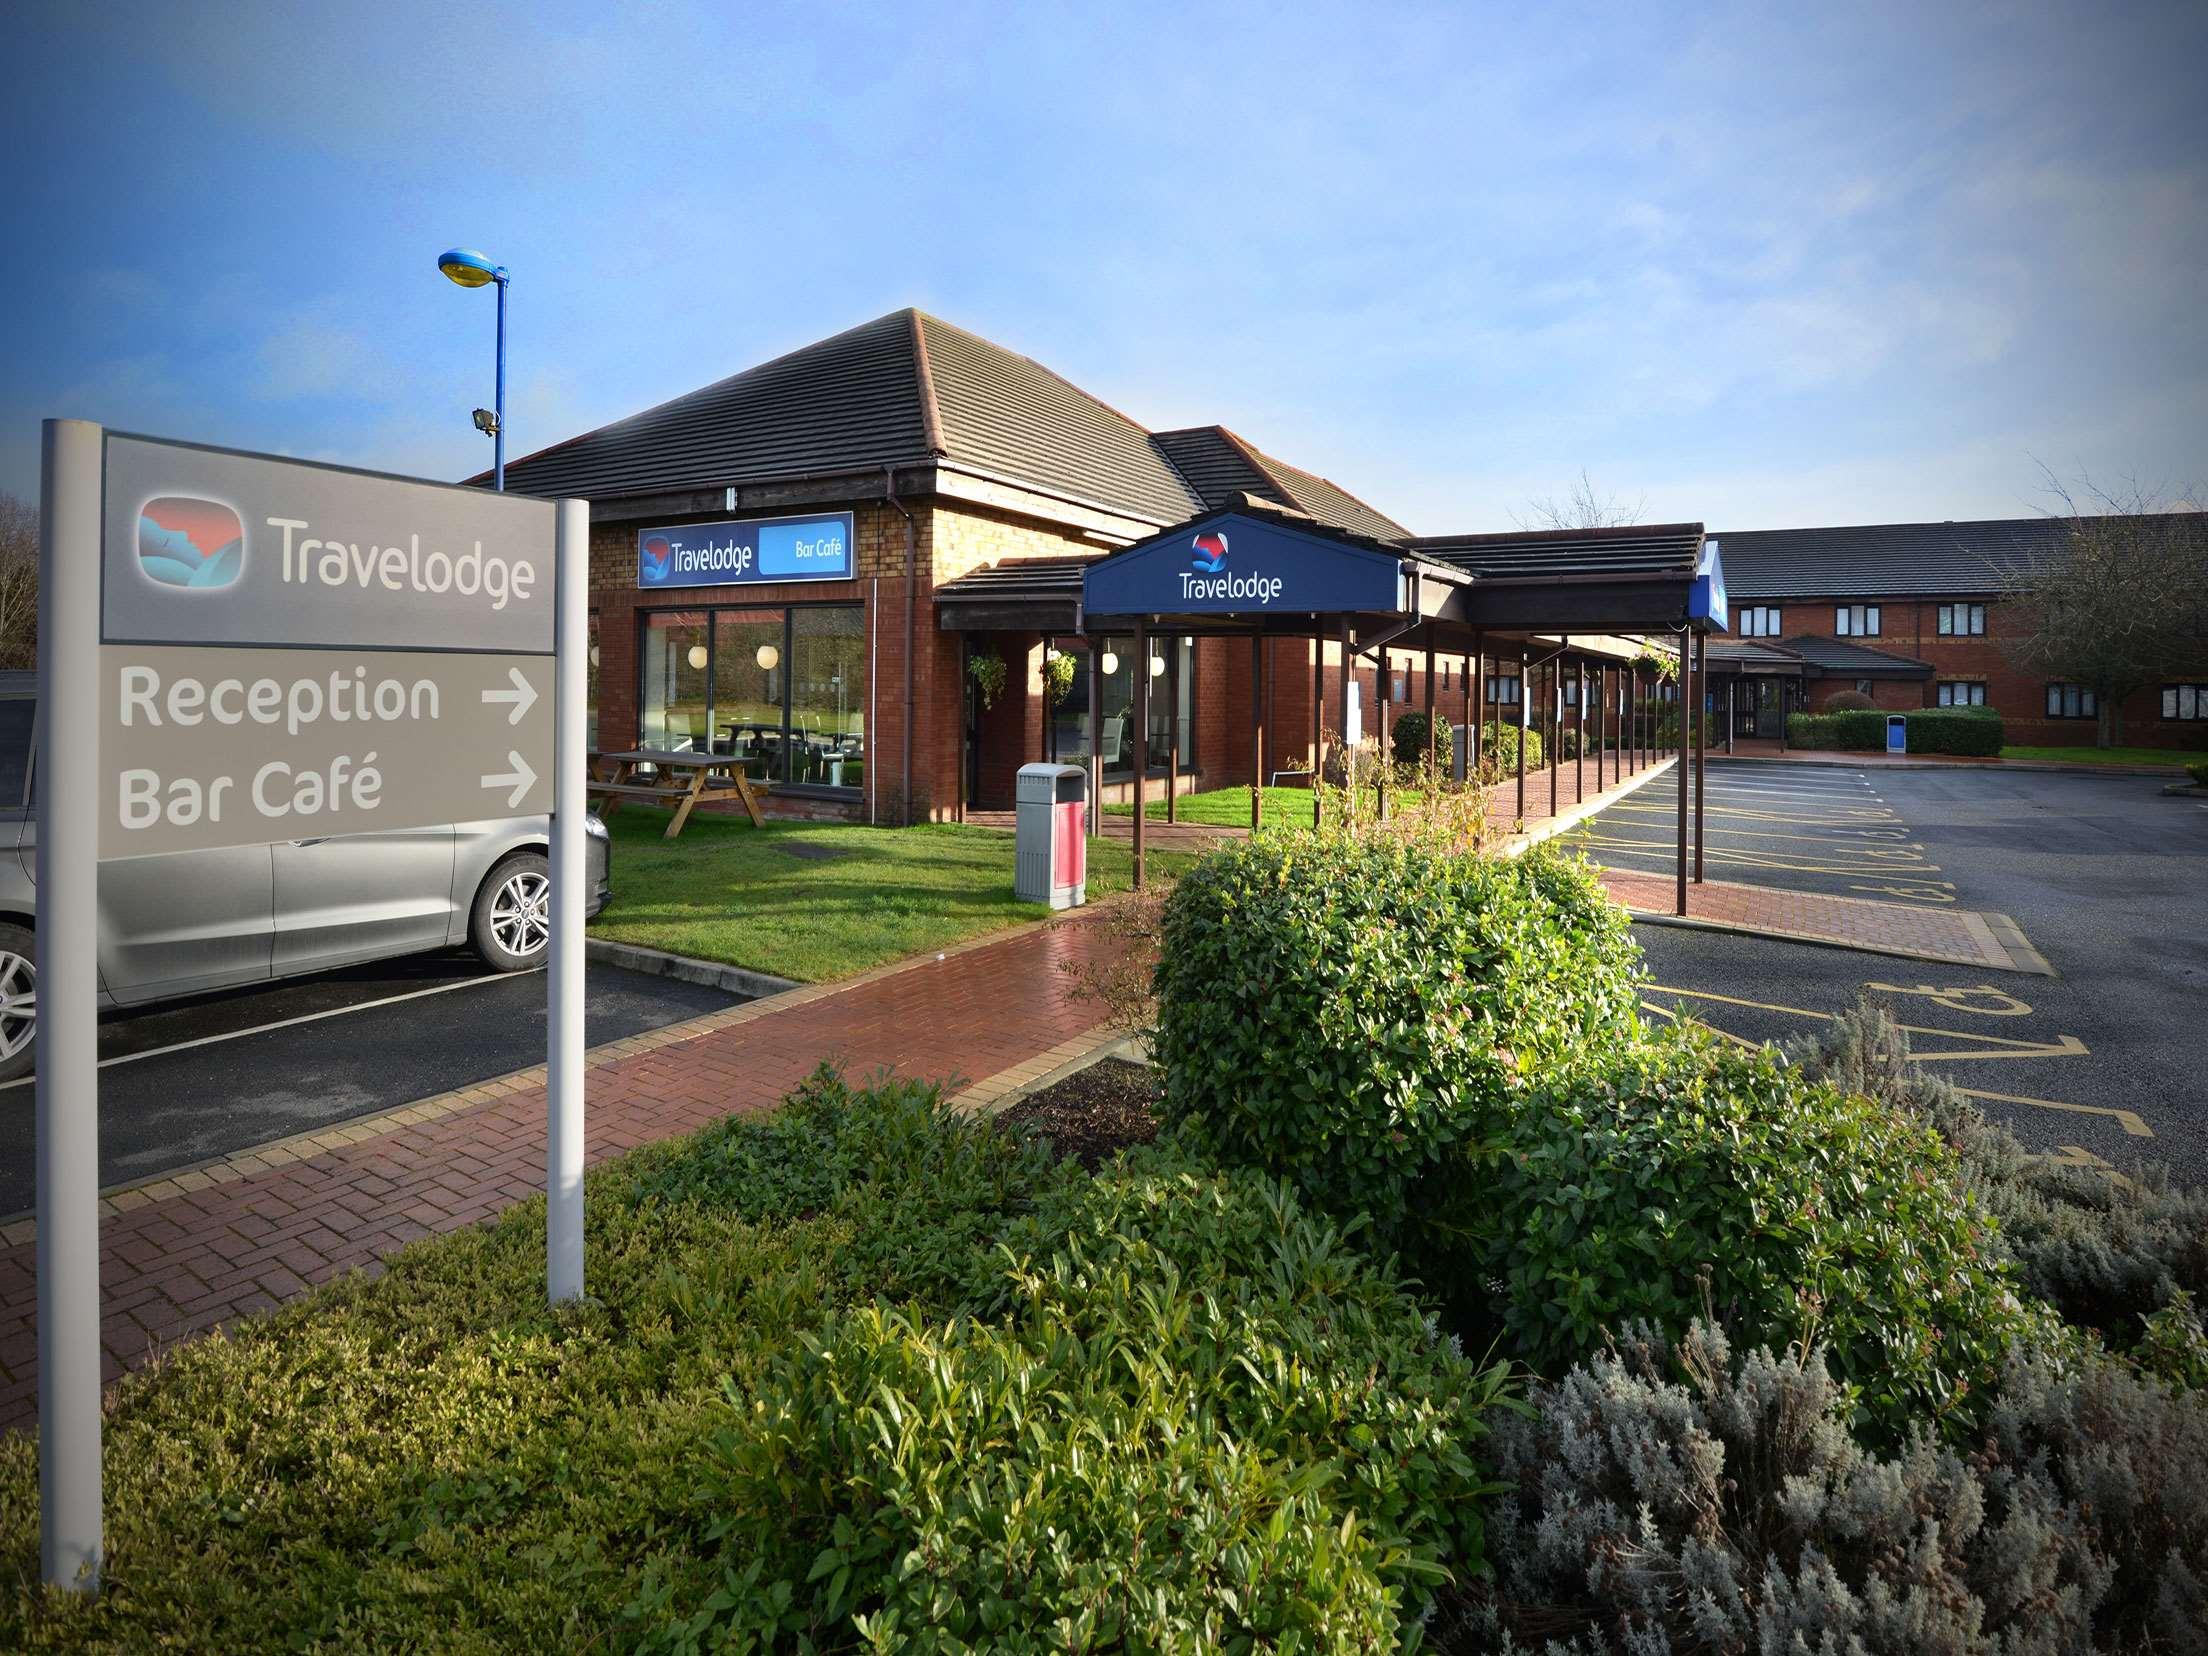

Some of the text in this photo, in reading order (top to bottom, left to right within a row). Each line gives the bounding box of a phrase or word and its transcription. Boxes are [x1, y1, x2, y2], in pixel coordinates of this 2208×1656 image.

[267, 517, 536, 609] Travelodge
[672, 539, 752, 576] Travelodge
[796, 538, 842, 558] Bar Café
[1179, 571, 1283, 604] Travelodge
[119, 665, 440, 735] Reception
[119, 752, 383, 830] Bar Café
